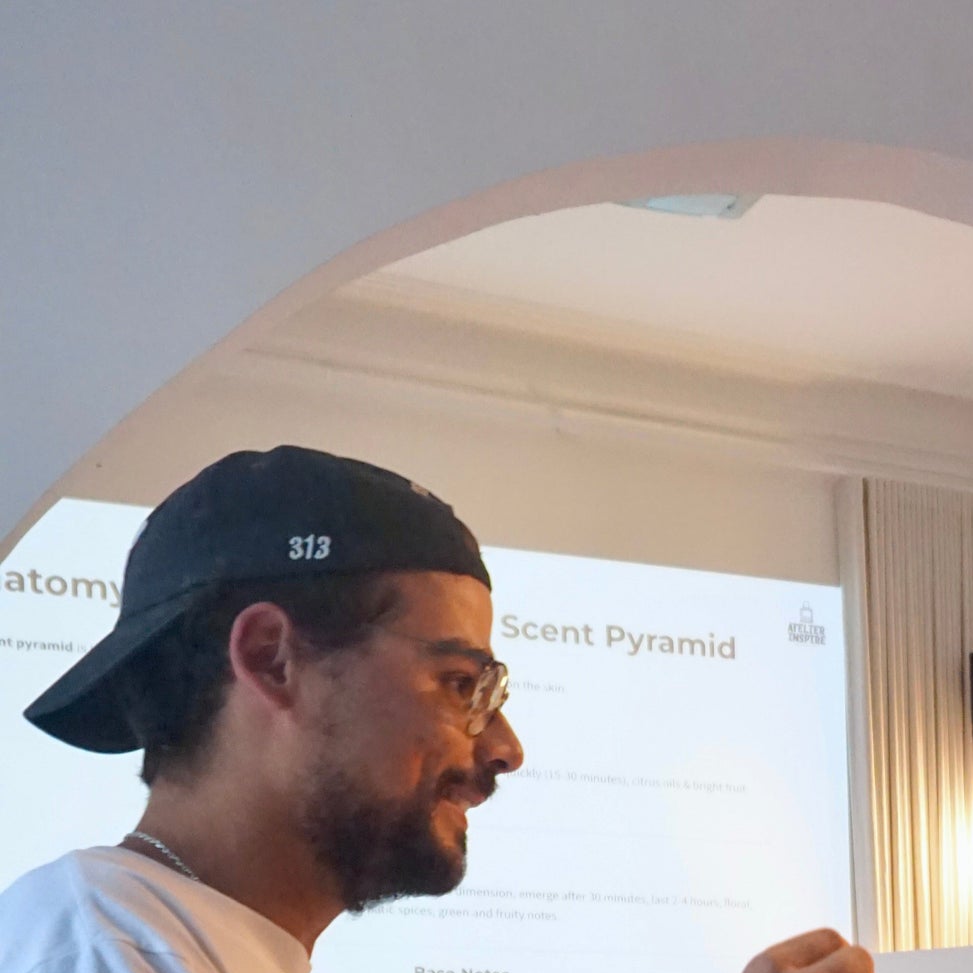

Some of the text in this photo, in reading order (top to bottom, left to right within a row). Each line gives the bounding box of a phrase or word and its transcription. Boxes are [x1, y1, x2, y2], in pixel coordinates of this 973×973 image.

[289, 534, 331, 560] 313
[500, 614, 595, 647] Scent
[606, 624, 736, 660] Pyramid
[788, 622, 825, 636] ATELIER
[16, 640, 73, 653] pyramid
[522, 680, 541, 691] the
[519, 890, 559, 903] emerge
[561, 890, 586, 902] after
[398, 906, 435, 918] spices,
[438, 907, 470, 920] green
[472, 907, 494, 919] and
[495, 907, 526, 922] fruity
